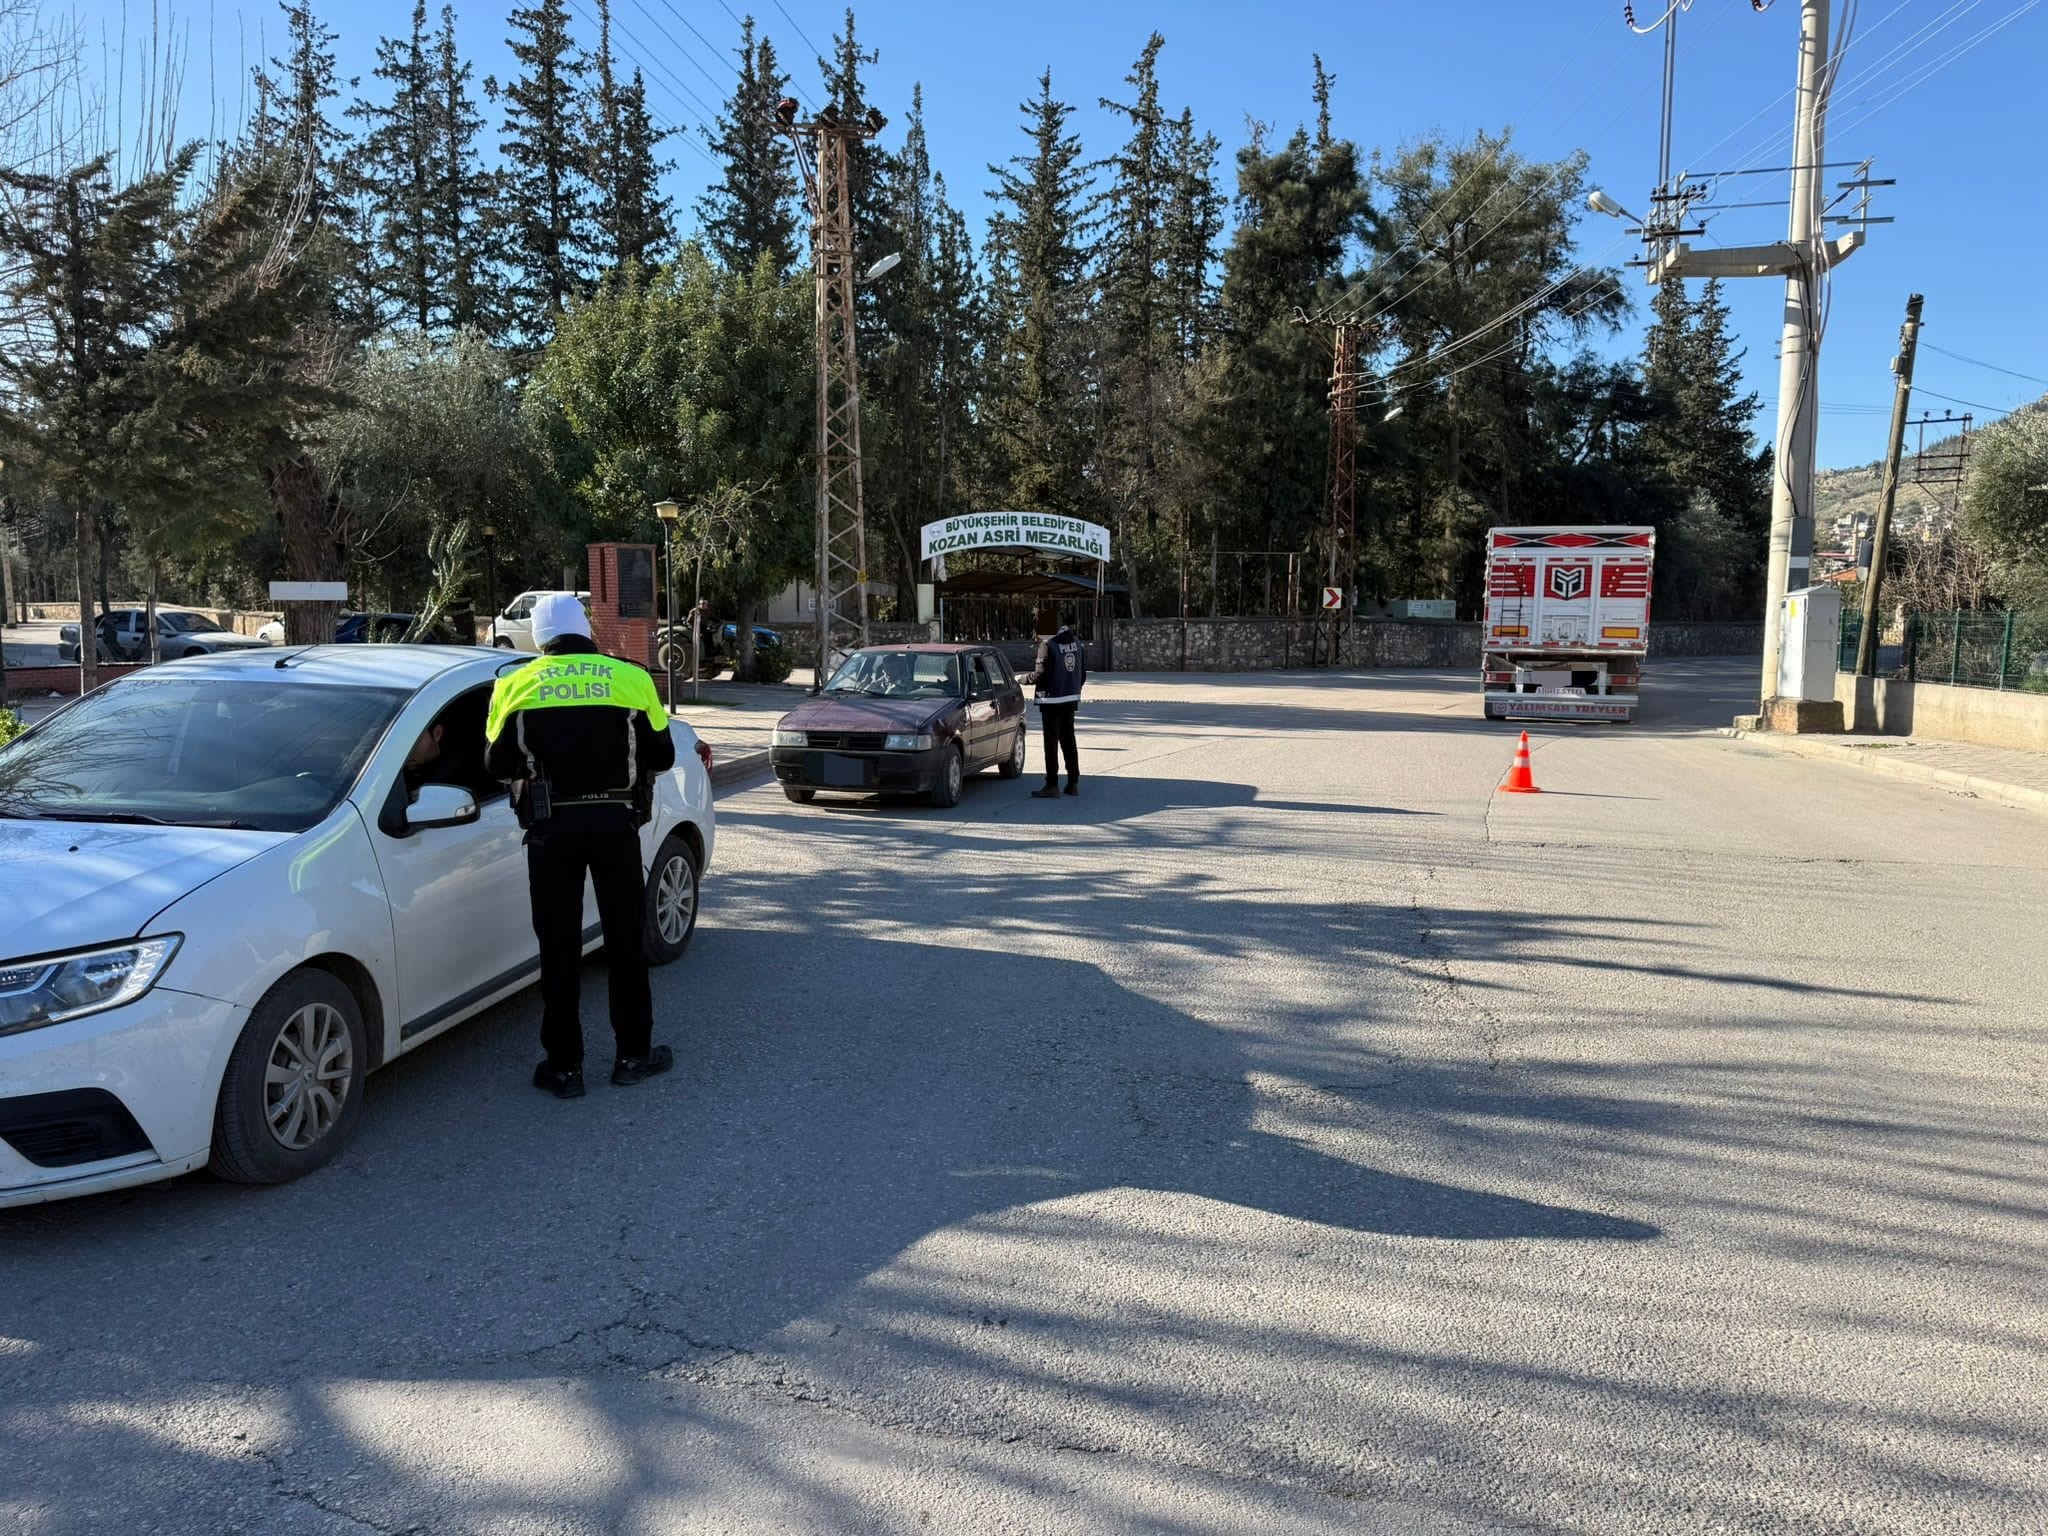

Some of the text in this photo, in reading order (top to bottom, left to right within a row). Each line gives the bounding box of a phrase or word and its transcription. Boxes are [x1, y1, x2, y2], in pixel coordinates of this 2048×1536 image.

[945, 513, 1085, 535] BÜYÜKŞEHİR BELEDİYESİ
[928, 527, 1103, 556] KOZAN ASRİ MEZARLIĞI
[540, 682, 611, 701] POLİSİ
